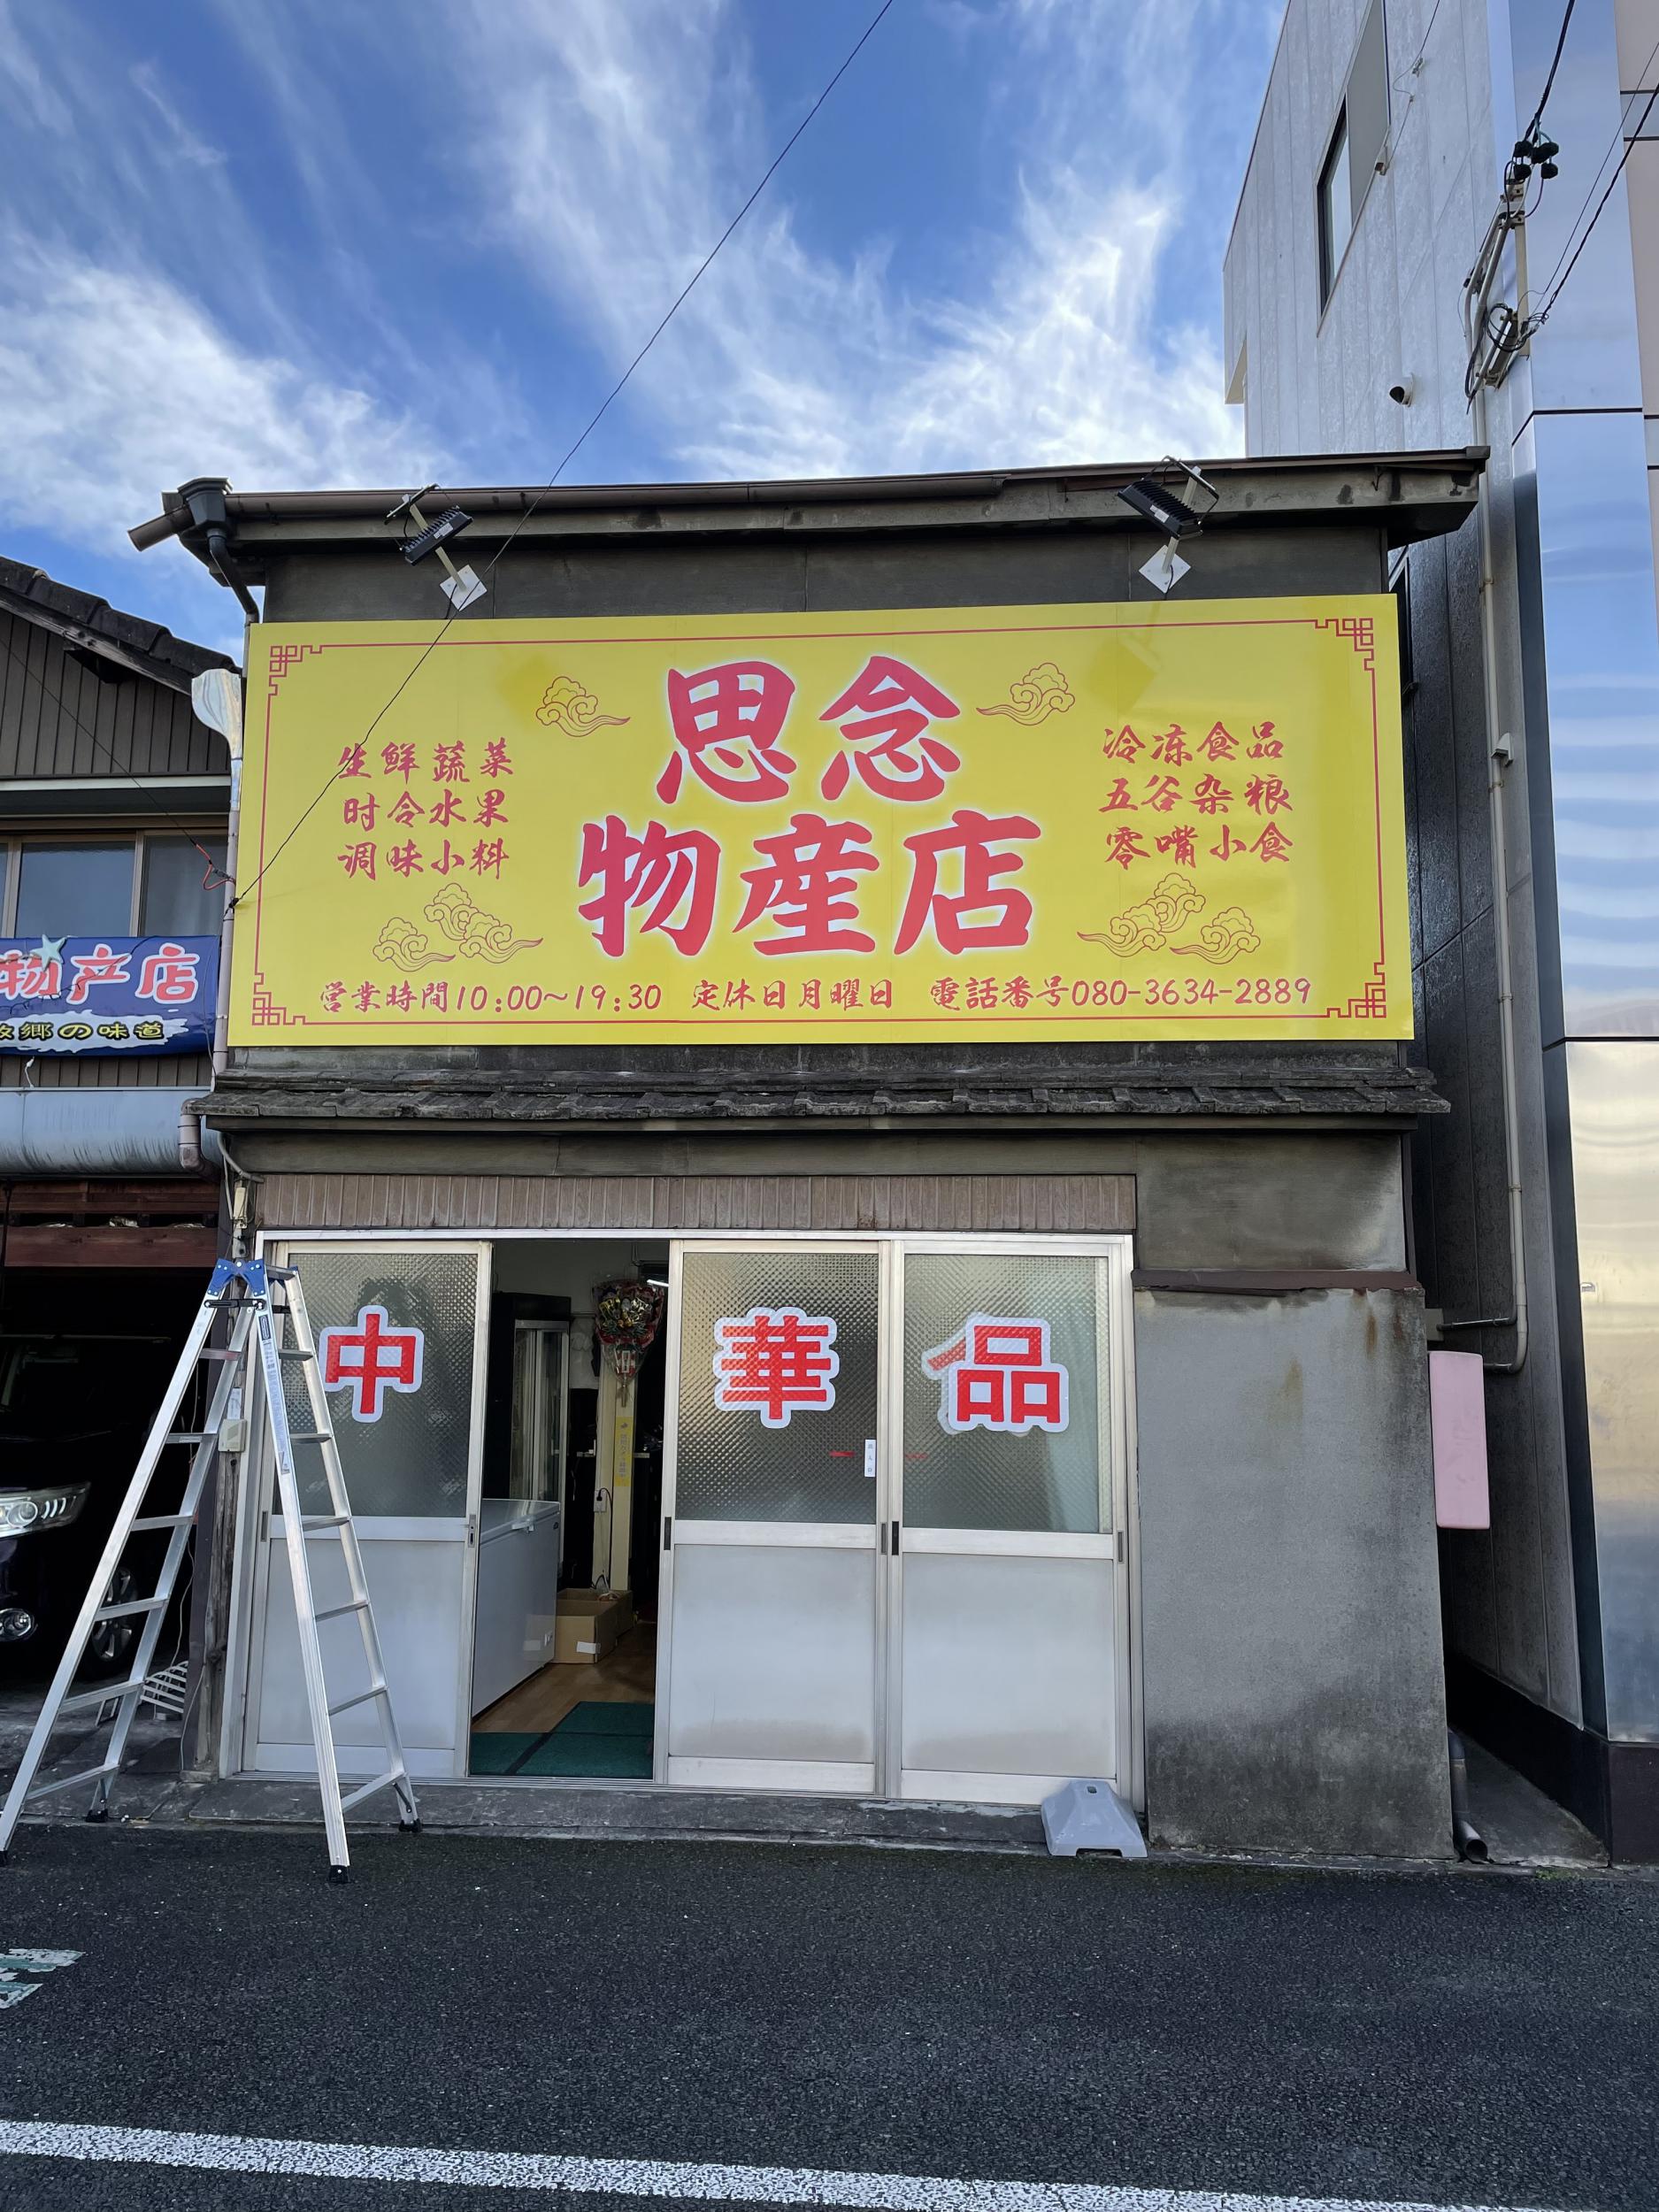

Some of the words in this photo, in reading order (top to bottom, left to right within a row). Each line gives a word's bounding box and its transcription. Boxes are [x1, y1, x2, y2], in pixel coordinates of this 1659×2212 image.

[657, 655, 961, 804] 思念
[1102, 721, 1284, 767] 冷冻食品
[343, 788, 509, 832] 时令水果
[1099, 773, 1293, 815] 五谷杂粮
[338, 837, 510, 880] 调味小料
[1104, 821, 1293, 870] 零嘴小食
[578, 810, 1041, 957] 物産店
[691, 978, 893, 1011] 定休日月曜日
